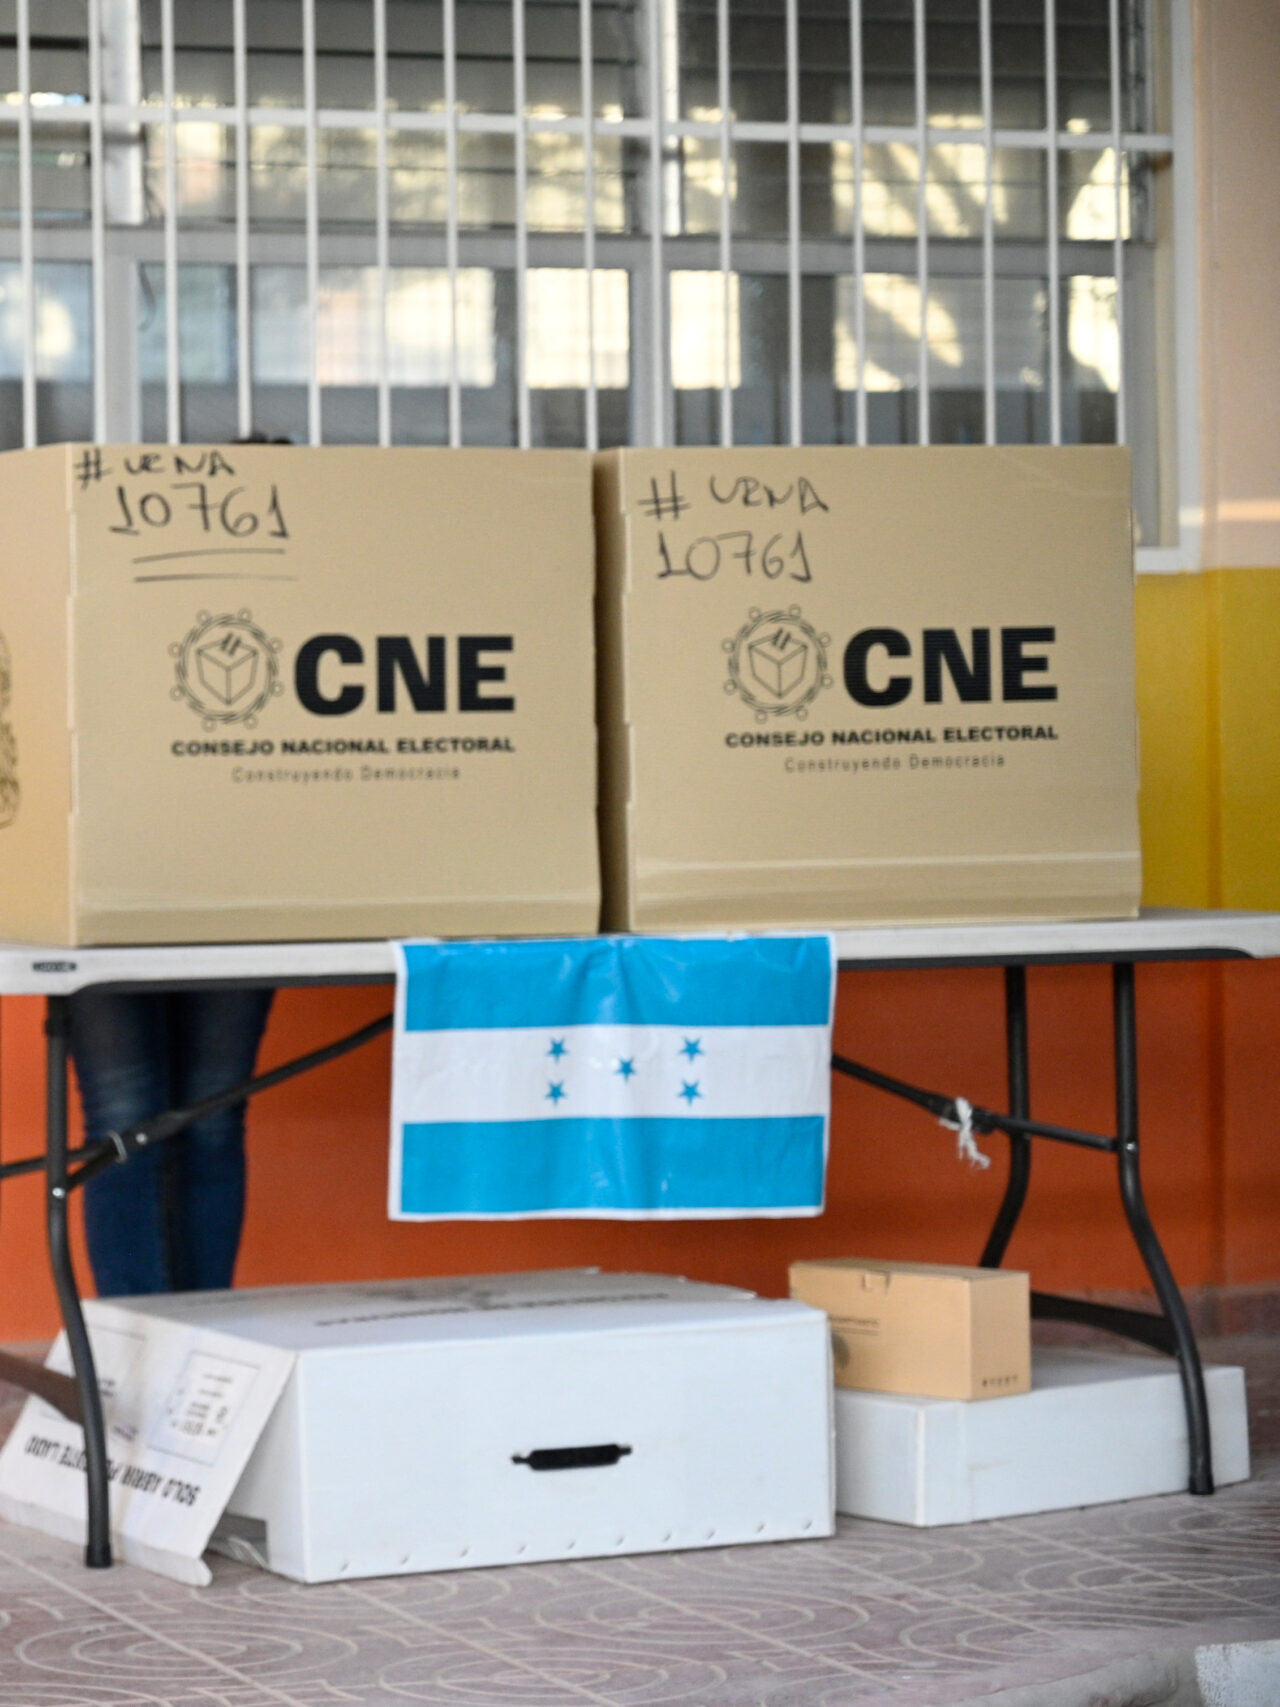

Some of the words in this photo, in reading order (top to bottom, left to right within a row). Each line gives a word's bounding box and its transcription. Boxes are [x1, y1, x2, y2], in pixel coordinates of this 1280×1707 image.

[74, 448, 112, 489] #
[109, 483, 289, 538] 10761
[638, 469, 691, 520] #
[709, 475, 829, 515] URNA
[657, 530, 812, 583] 10761
[294, 633, 515, 716] CNE
[842, 625, 1058, 707] CNE
[171, 739, 275, 757] CONSEJO
[280, 738, 389, 755] NACIONAL
[397, 736, 516, 754] ELECTORAL
[725, 731, 825, 748] CONSEJO
[831, 727, 936, 745] NACIONAL
[942, 725, 1059, 742] ELECTORAL
[231, 766, 354, 785] Construyendo
[360, 765, 460, 781] Democracia
[784, 755, 901, 774] Construyendo
[908, 753, 1005, 770] Democracia
